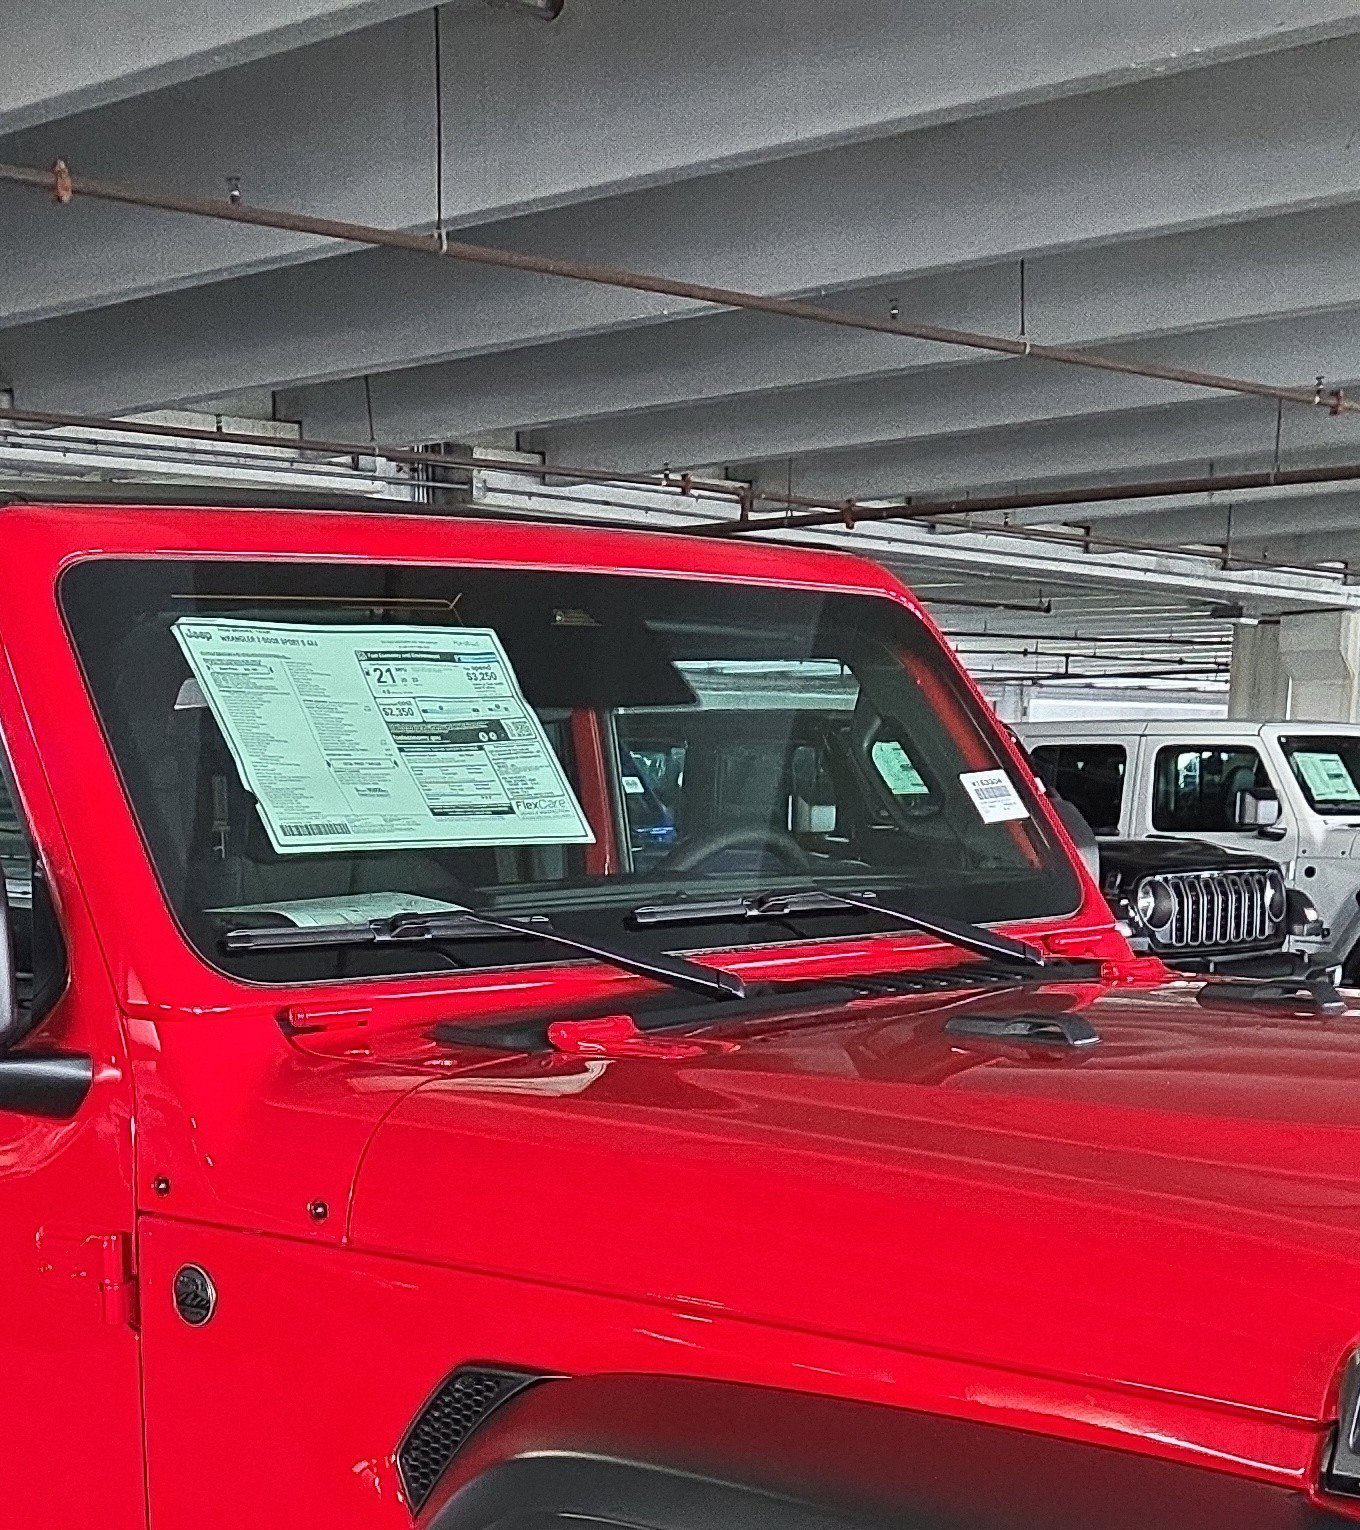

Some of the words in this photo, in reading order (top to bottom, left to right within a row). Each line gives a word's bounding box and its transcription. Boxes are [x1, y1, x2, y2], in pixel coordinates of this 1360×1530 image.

[373, 667, 396, 684] 21
[466, 671, 497, 681] $3,250
[382, 707, 414, 717] $2,350
[515, 799, 566, 810] FlexCare
